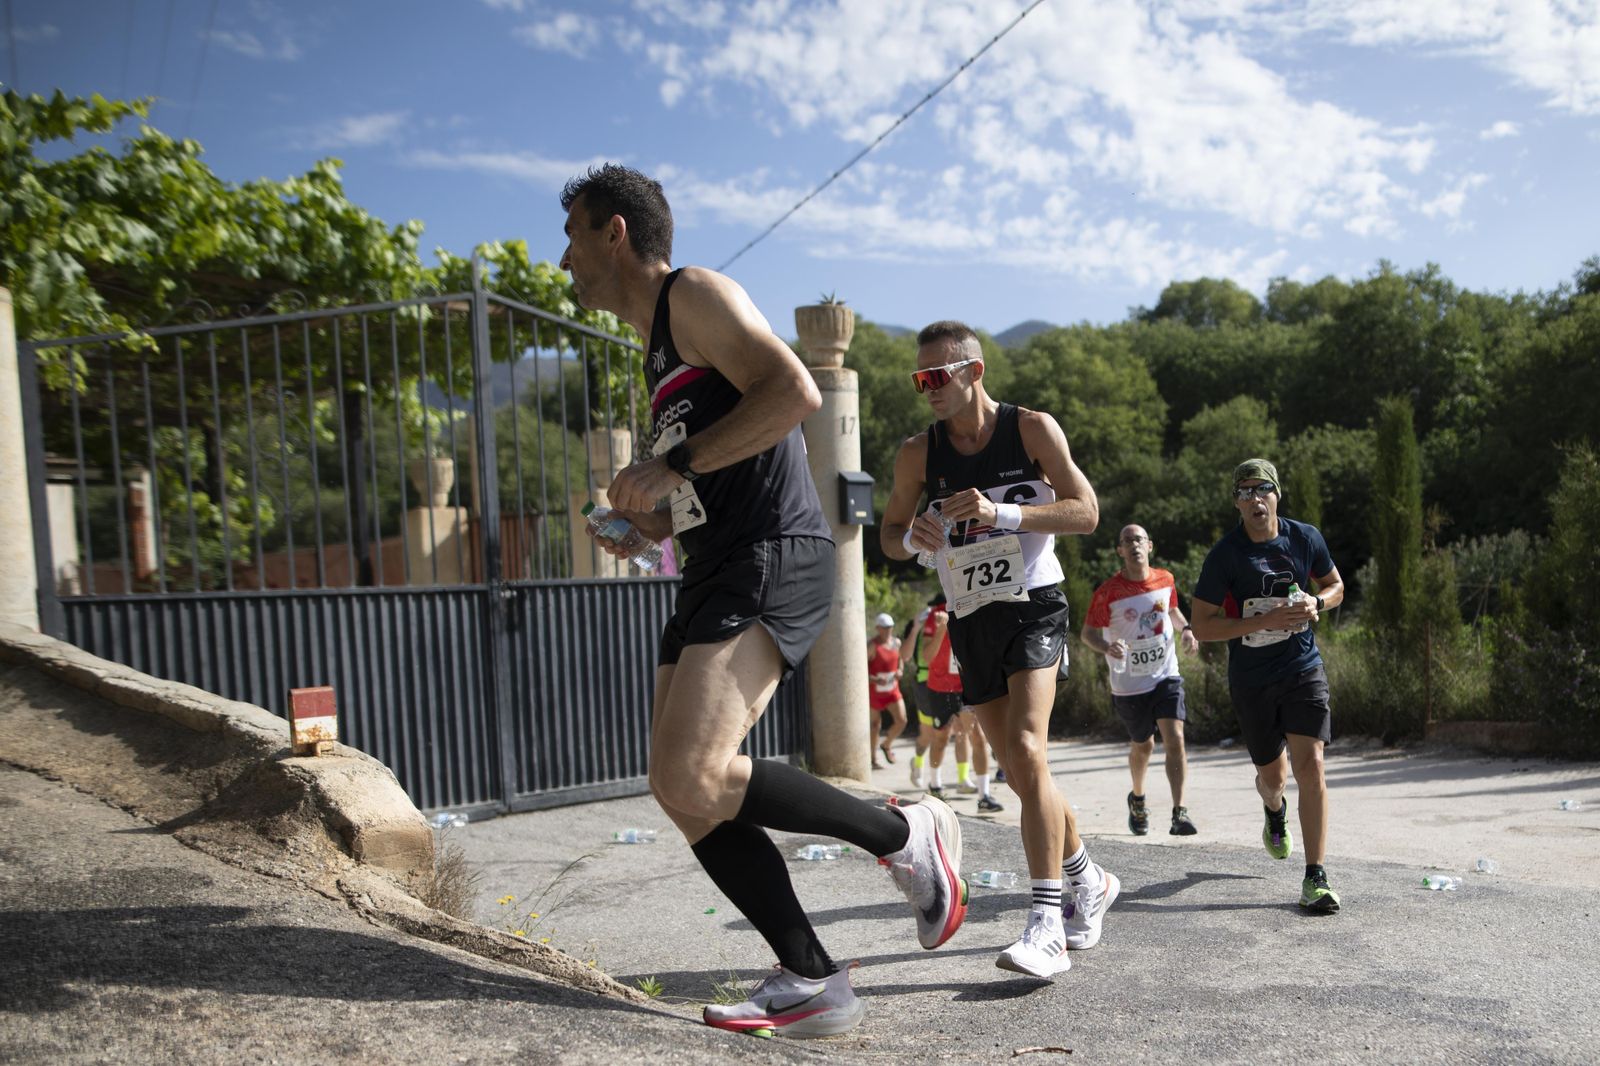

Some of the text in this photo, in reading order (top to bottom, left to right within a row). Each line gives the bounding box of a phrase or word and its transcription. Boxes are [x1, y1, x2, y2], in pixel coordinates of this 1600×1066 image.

[840, 415, 856, 436] 17
[963, 559, 1012, 591] 732
[1131, 647, 1165, 665] 3032
